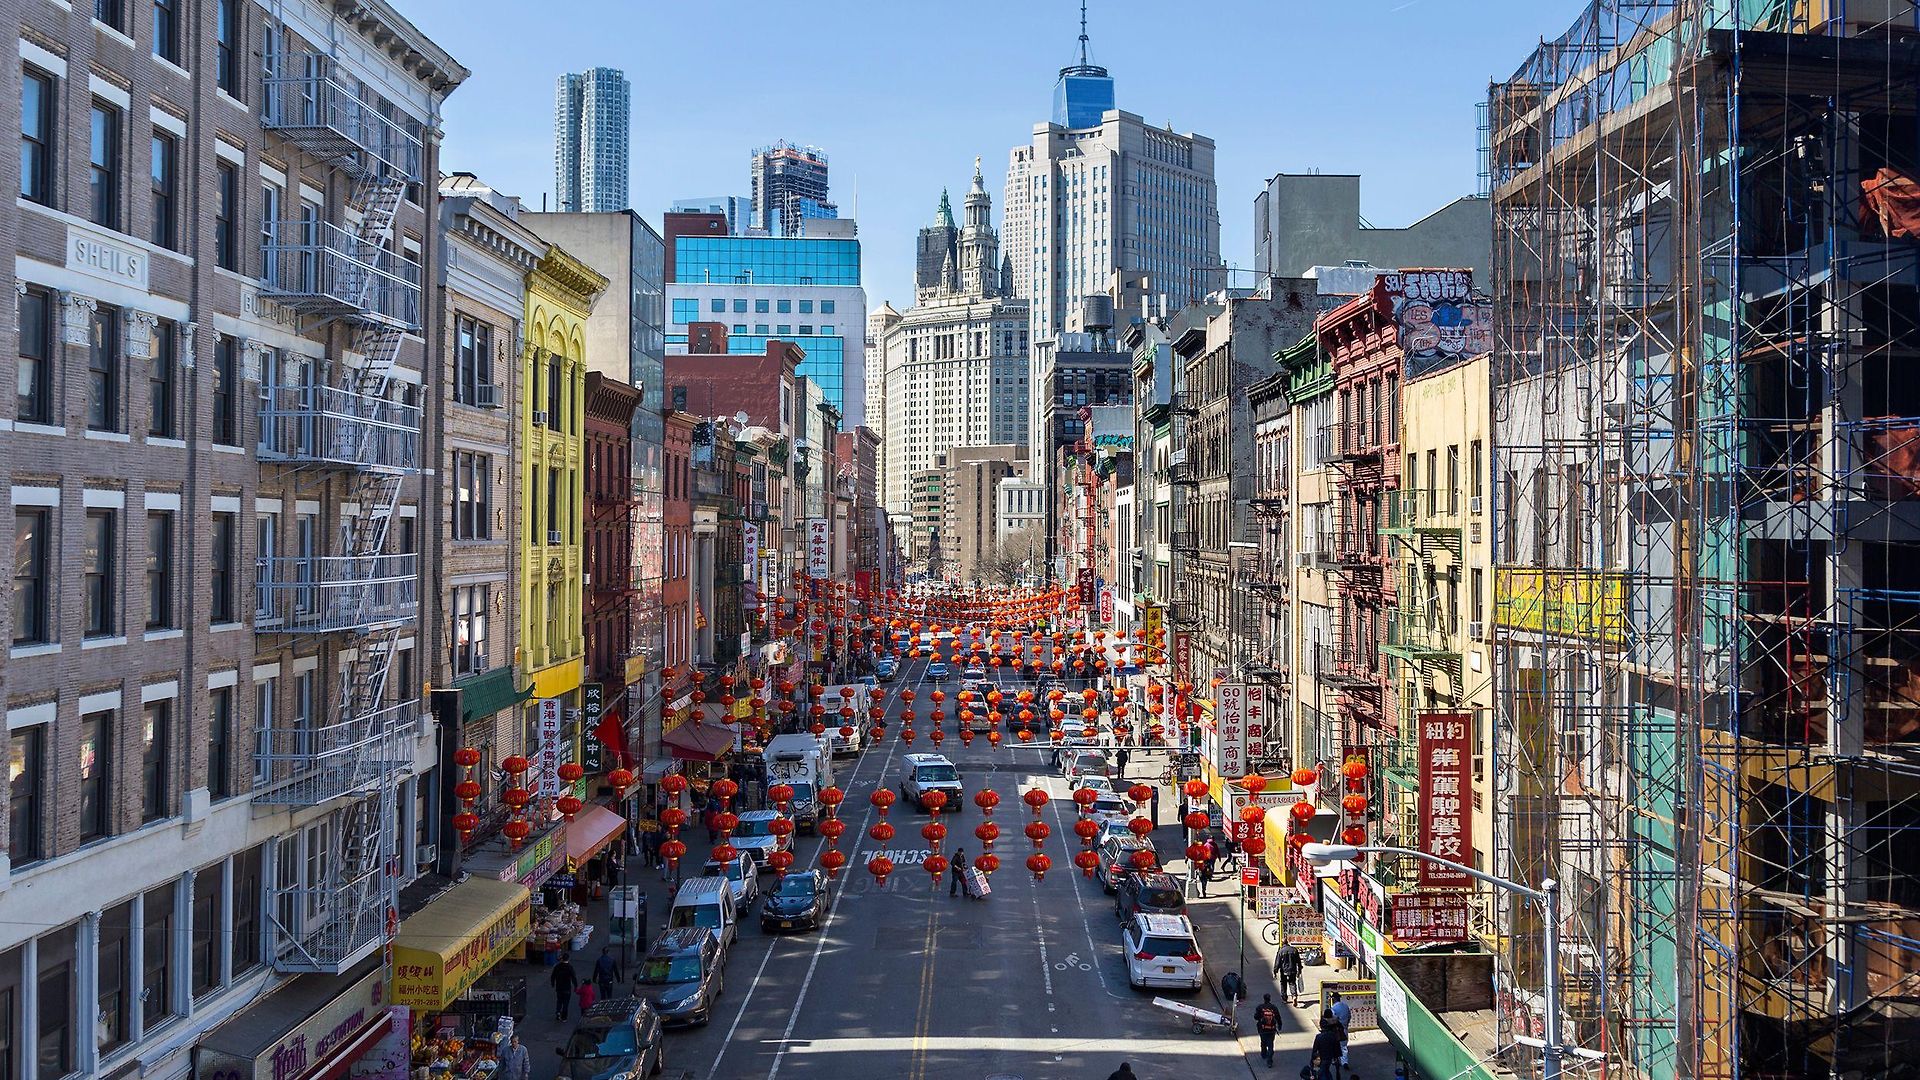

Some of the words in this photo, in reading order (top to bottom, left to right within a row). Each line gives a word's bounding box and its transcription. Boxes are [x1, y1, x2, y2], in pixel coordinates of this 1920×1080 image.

[75, 238, 138, 279] SHEILS
[243, 293, 297, 326] BUILDING
[1222, 687, 1241, 775] 60號怡豐商場
[1425, 721, 1465, 740] 紐約
[1431, 747, 1461, 857] 第一駕駛學校
[398, 984, 439, 995] 福州小吃店
